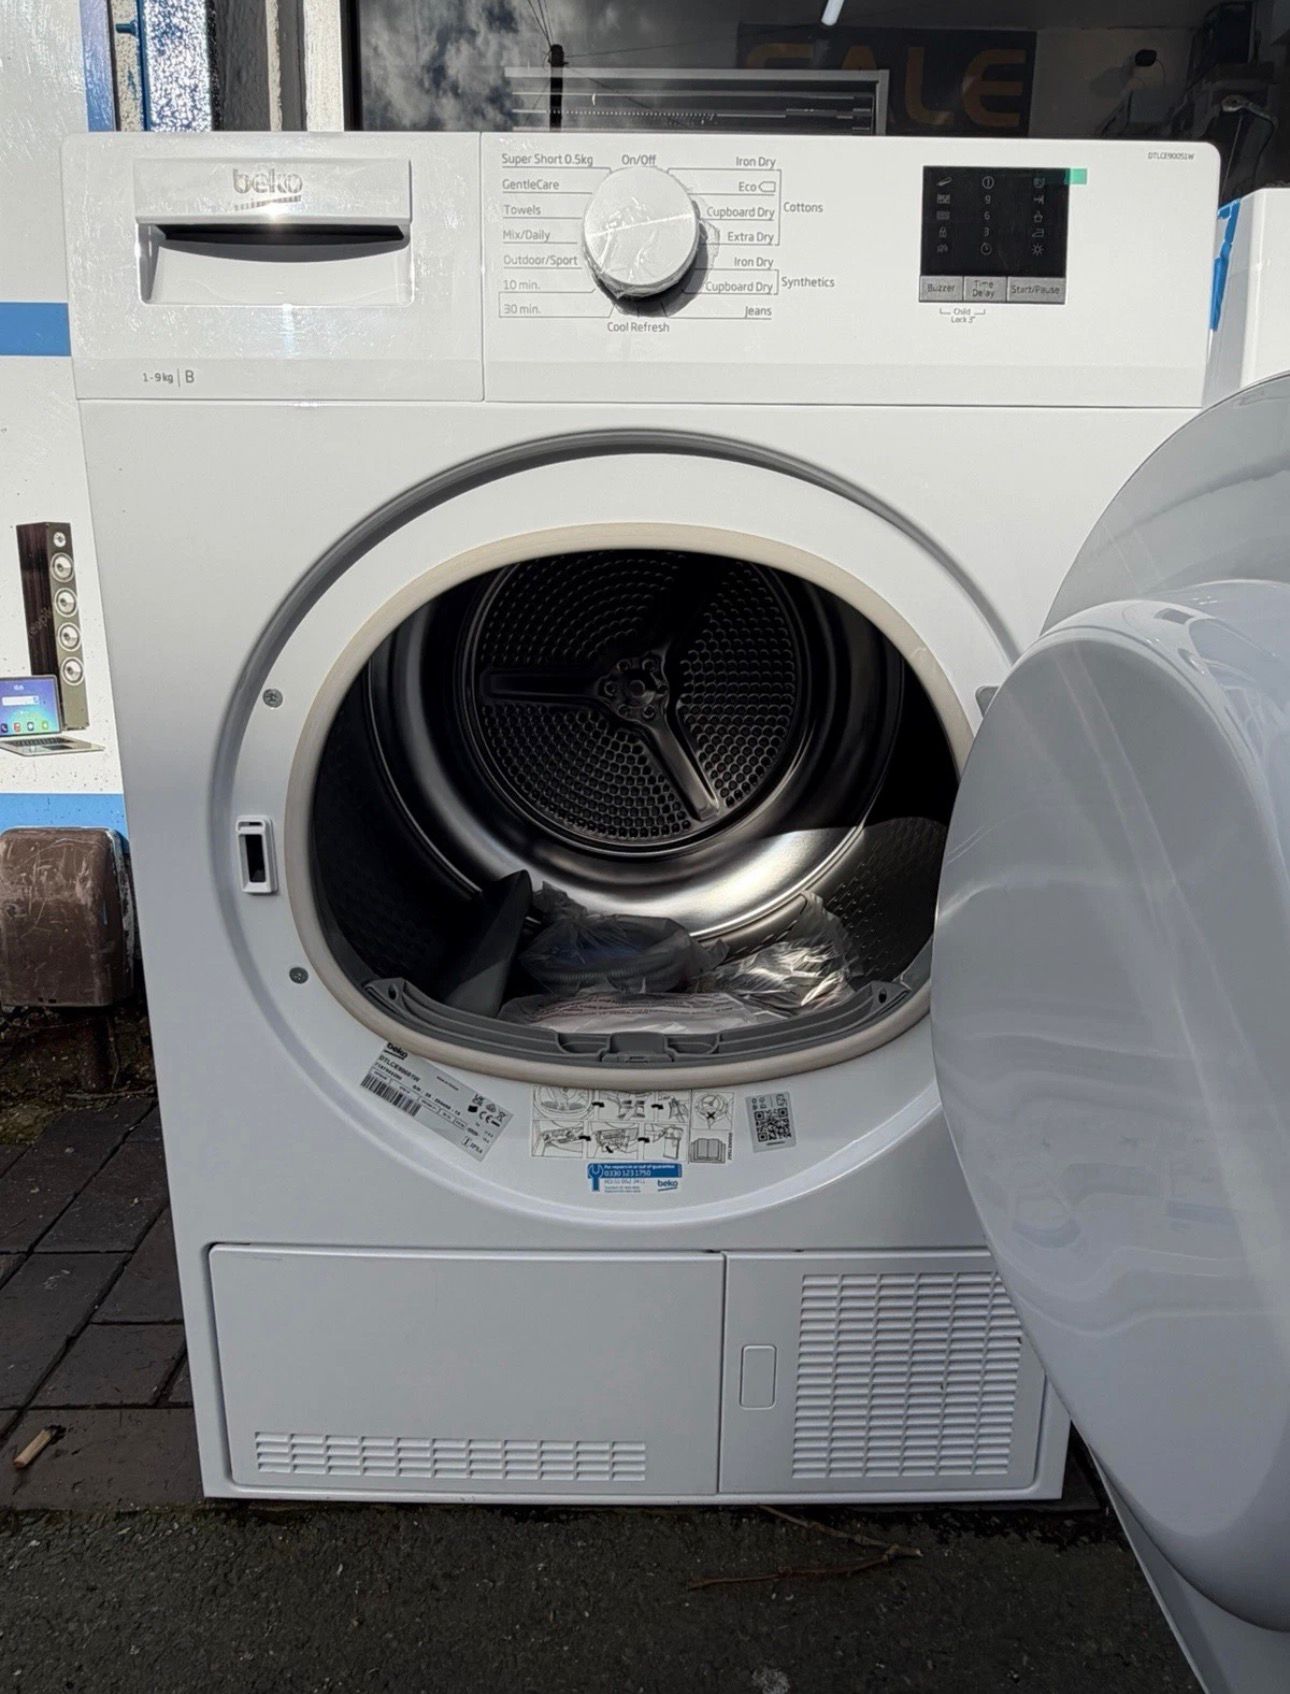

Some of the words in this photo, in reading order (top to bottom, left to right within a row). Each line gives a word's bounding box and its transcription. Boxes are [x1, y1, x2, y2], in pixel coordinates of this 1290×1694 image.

[502, 154, 532, 166] Super
[535, 154, 563, 165] Short
[564, 154, 594, 168] 0.5kg
[621, 155, 656, 166] On/Off
[736, 156, 756, 167] Iron
[758, 157, 776, 169] Dry
[233, 168, 303, 193] beko
[502, 179, 560, 190] GentleCare
[738, 182, 758, 192] Eco
[984, 195, 992, 204] 9
[503, 205, 542, 216] Towels
[783, 201, 824, 213] Cottons
[707, 207, 754, 220] Cupboard
[757, 207, 775, 220] Dry
[984, 211, 990, 220] 6
[503, 230, 551, 242] Mix/Daily
[728, 232, 754, 242] Extra
[756, 232, 774, 245] Dry
[503, 255, 578, 267] Outdoor/Sport
[734, 256, 753, 267] Iron
[756, 258, 774, 270] Dry
[503, 280, 517, 290] 10
[520, 280, 541, 290] min.
[705, 281, 753, 294] Cupboard
[756, 282, 773, 294] Dry
[781, 276, 836, 288] Synthetics
[974, 280, 994, 288] Time
[927, 284, 955, 292] Buzzer
[972, 288, 995, 298] Delay
[1011, 284, 1060, 294] Start/Pause
[503, 304, 517, 314] 30
[520, 305, 542, 314] min.
[744, 306, 772, 318] Jeans
[954, 308, 971, 316] Child
[951, 316, 967, 324] Lock
[607, 322, 630, 333] Cool
[631, 322, 670, 334] Refresh
[185, 369, 195, 384] B
[658, 1179, 678, 1188] beko
